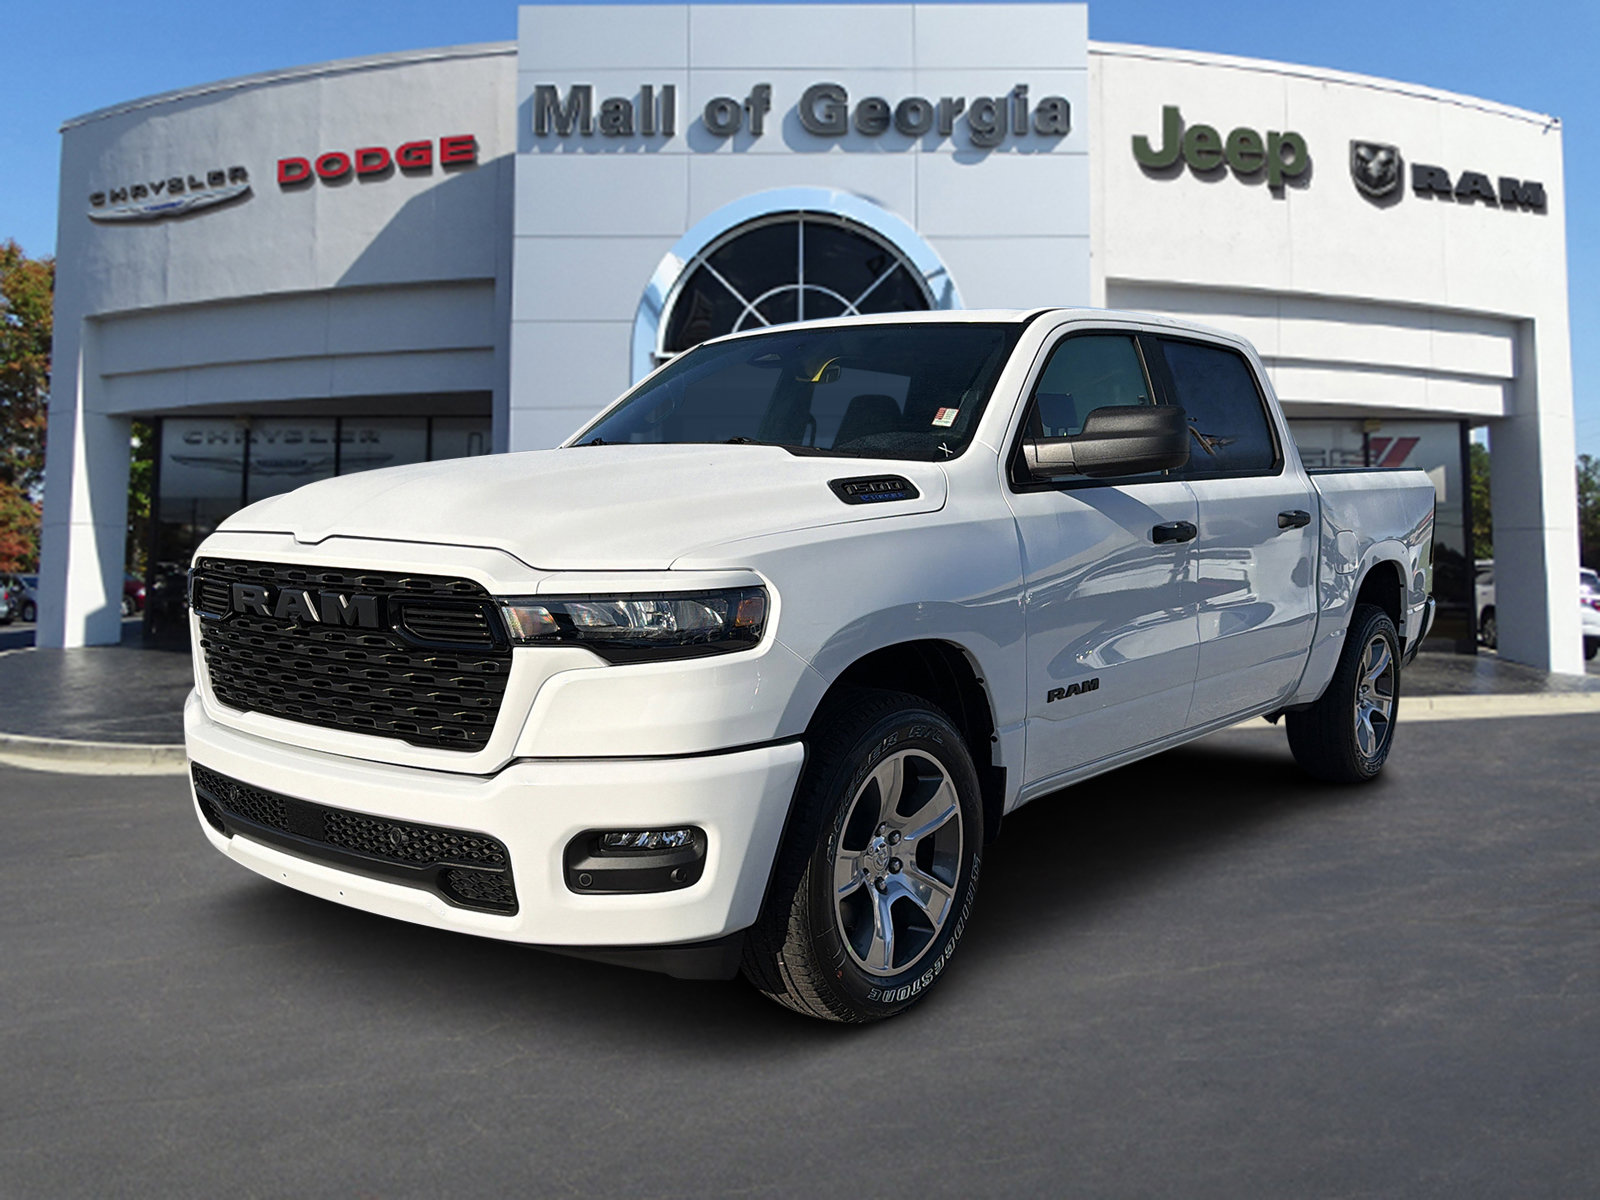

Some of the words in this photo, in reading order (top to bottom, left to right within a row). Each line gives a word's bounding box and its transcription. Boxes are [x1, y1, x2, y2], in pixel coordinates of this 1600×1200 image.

[531, 83, 676, 137] Mall
[703, 83, 772, 137] of
[800, 82, 1072, 148] Georgia
[277, 134, 477, 189] DODGE
[1132, 105, 1309, 194] Jeep
[89, 166, 249, 207] CHRYSLER
[1411, 163, 1546, 214] RAM
[842, 479, 905, 497] 1500
[232, 582, 379, 628] RAM
[1047, 677, 1099, 703] RAM
[866, 852, 982, 1003] BRIDGESTONE
